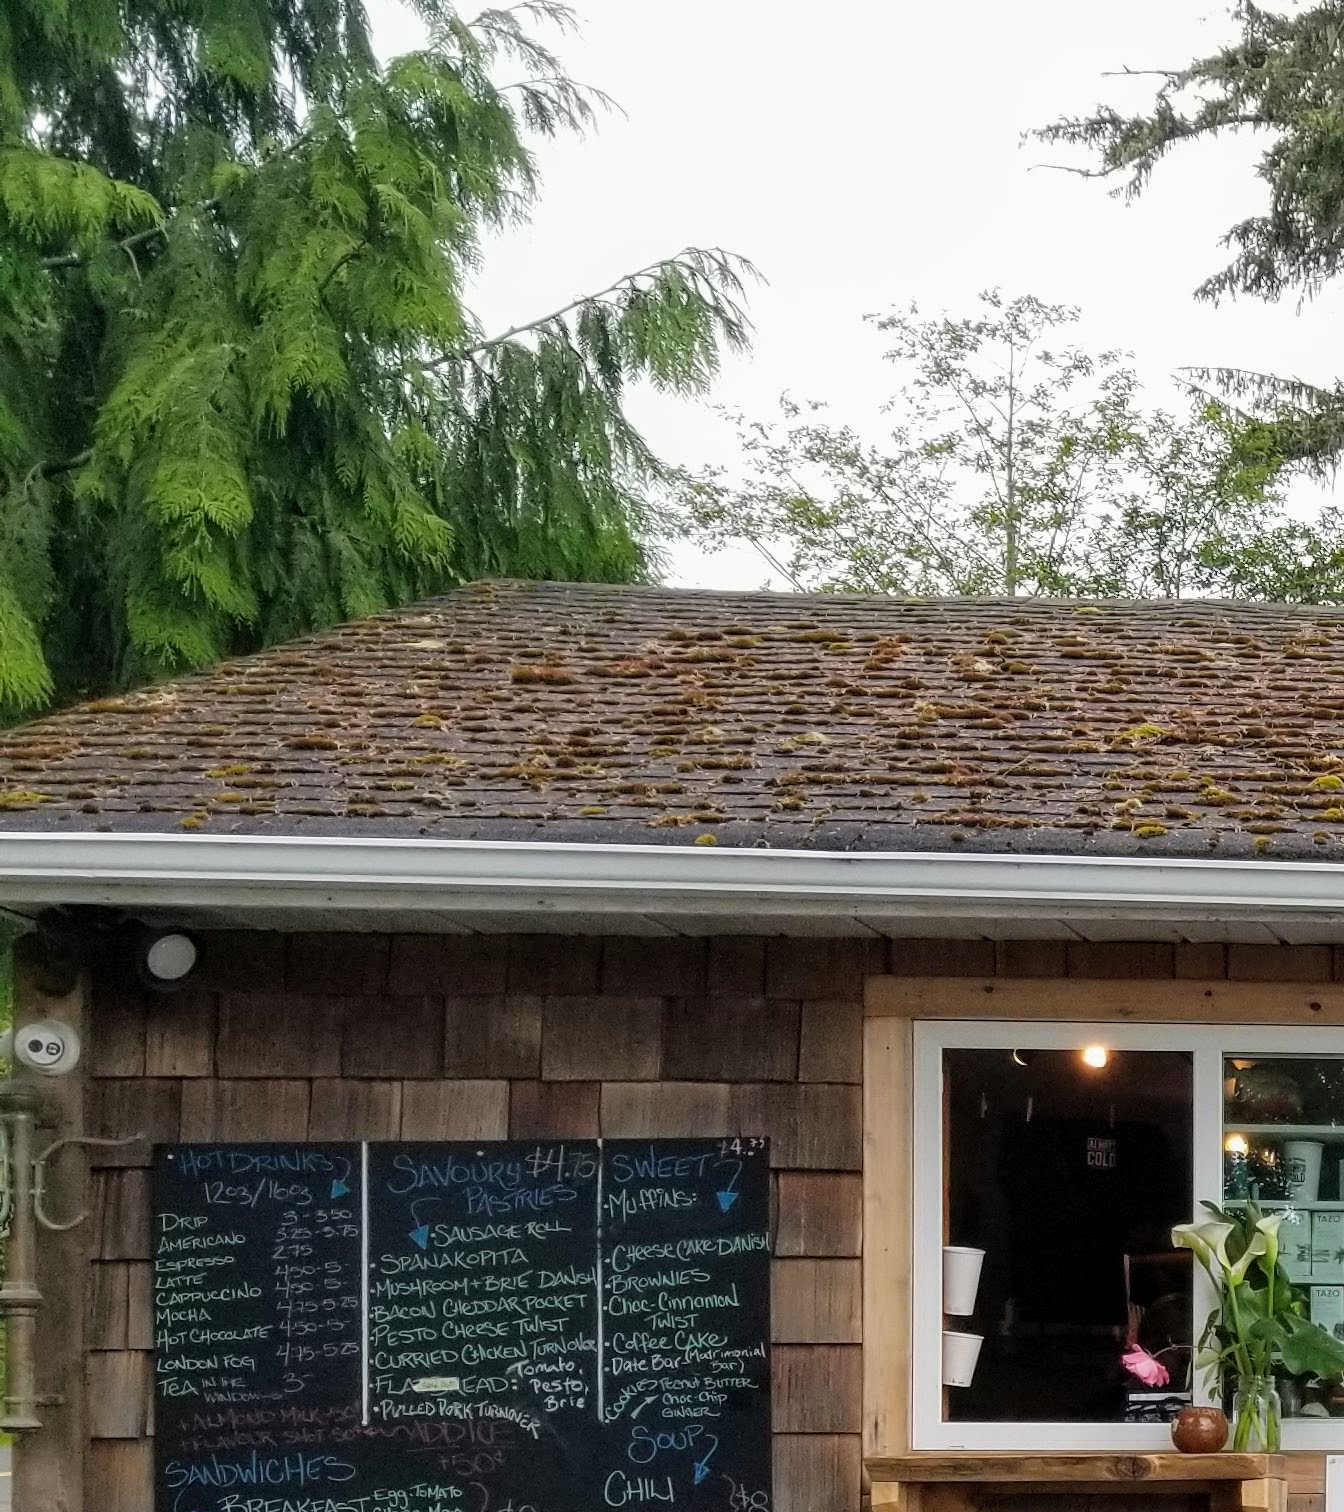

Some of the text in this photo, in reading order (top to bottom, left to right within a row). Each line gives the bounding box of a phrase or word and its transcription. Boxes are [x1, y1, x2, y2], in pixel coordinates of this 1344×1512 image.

[613, 1145, 714, 1182] SWEET
[466, 1185, 577, 1216] PASTRIES
[159, 1213, 208, 1231] DRIP
[158, 1234, 245, 1253] AMERICANO
[434, 1221, 571, 1246] SAUSAGE ROLL
[155, 1256, 234, 1271] ESPRESSO
[381, 1249, 528, 1274] SPANAKOPITA
[155, 1273, 207, 1289] LATTE
[376, 1267, 597, 1299] MUSHROOM BRIE DANISH
[609, 1269, 710, 1294] BROWNIES
[156, 1283, 262, 1305] CAPPUCCINO
[156, 1309, 211, 1327] MOCHA
[374, 1295, 587, 1322] BACON POCKET
[373, 1316, 569, 1346] PESTO TWIST
[644, 1312, 699, 1330] TWIST
[156, 1325, 273, 1353] HOT CHOCOLATE
[157, 1357, 254, 1372] LONDON FOG
[374, 1350, 458, 1369] CURRIED
[612, 1358, 647, 1375] Date
[704, 1377, 758, 1388] BUTTER
[379, 1400, 435, 1419] PULLED
[437, 1399, 473, 1419] PORK
[545, 1396, 584, 1411] Brie
[661, 1407, 720, 1418] GINGER
[165, 1451, 355, 1487] SANDWICHES
[604, 1470, 674, 1506] CHILI
